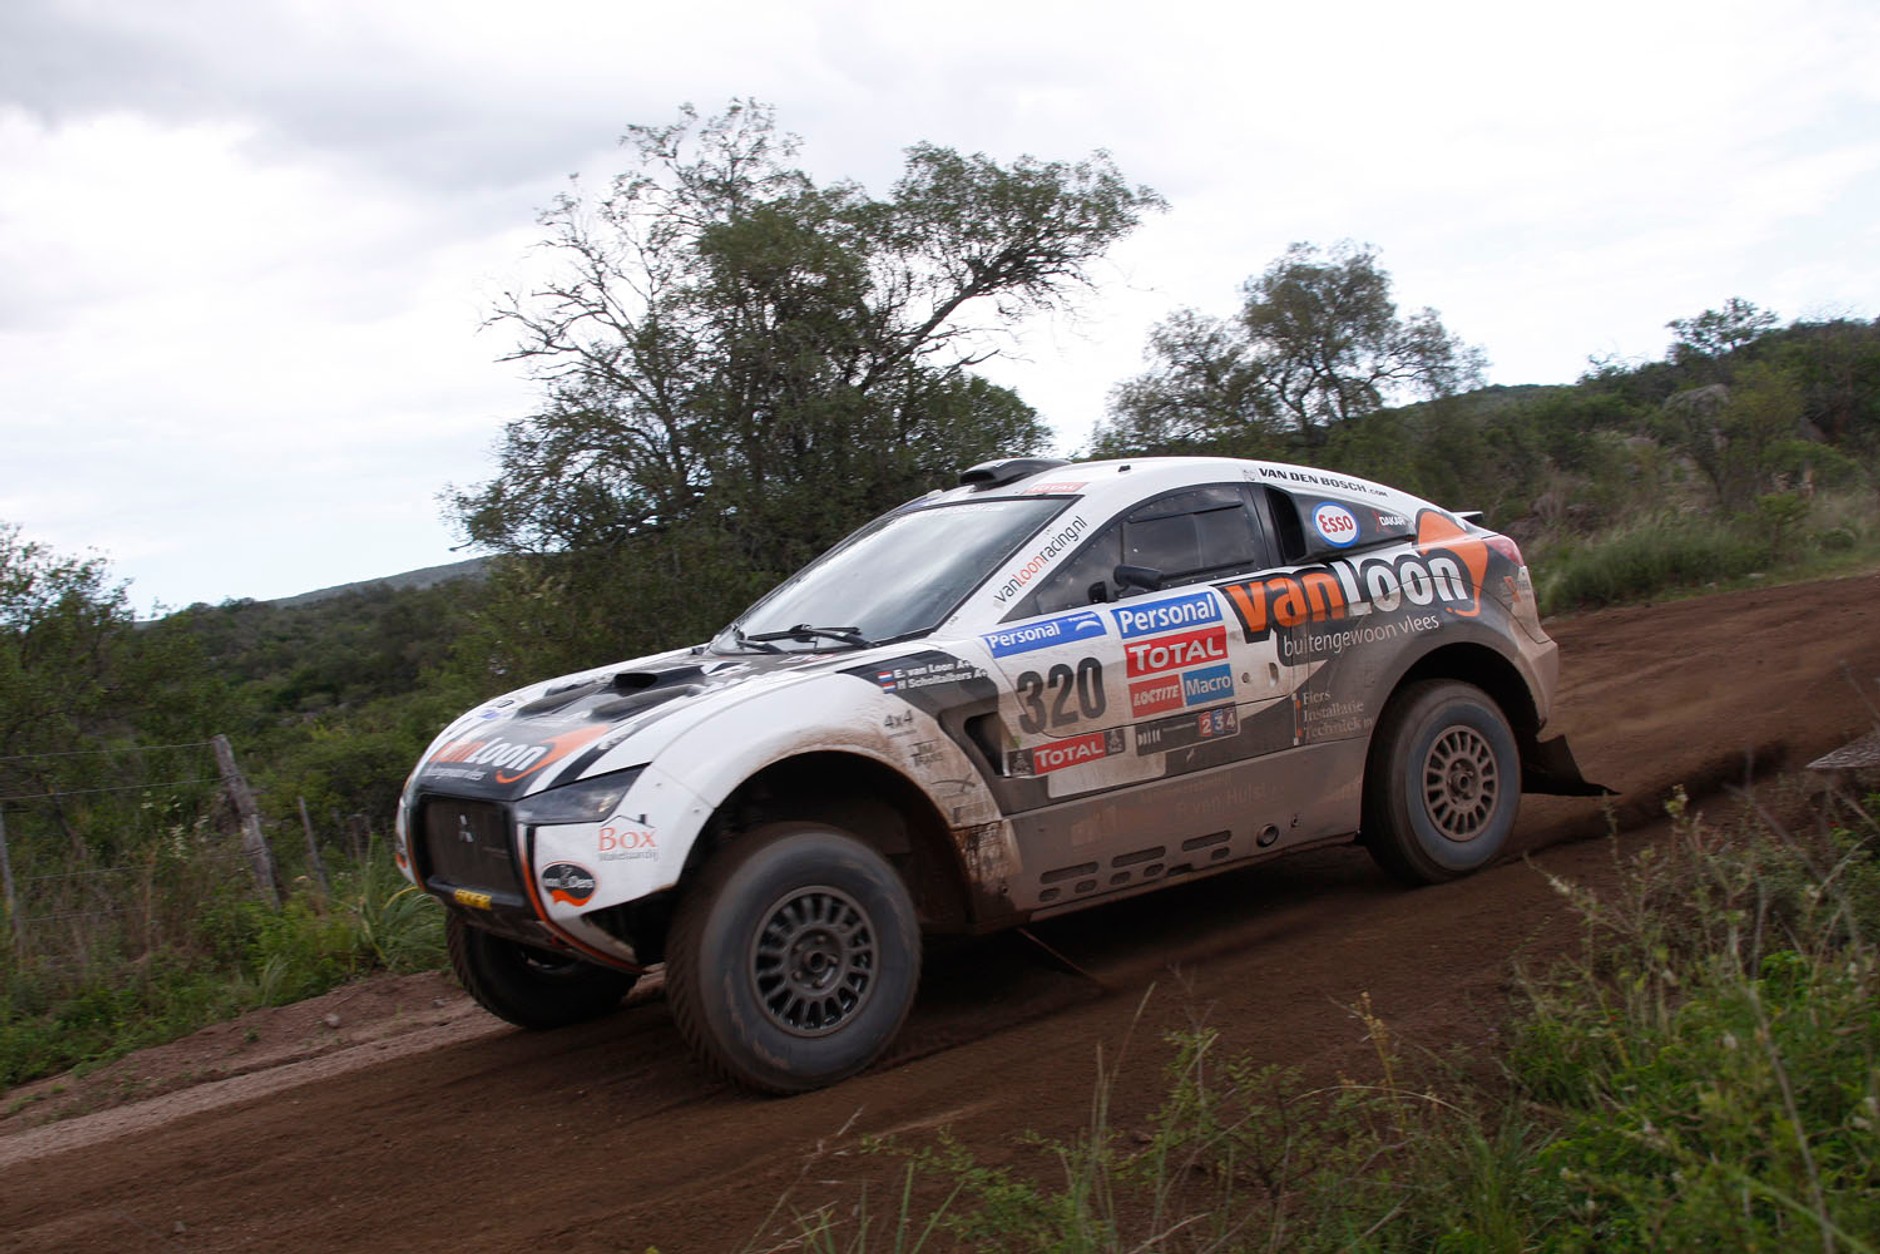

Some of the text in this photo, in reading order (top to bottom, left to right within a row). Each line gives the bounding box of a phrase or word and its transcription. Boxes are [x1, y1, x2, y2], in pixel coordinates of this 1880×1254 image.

[1258, 468, 1287, 480] VAN
[1290, 472, 1319, 484] DEN
[1321, 477, 1367, 493] BOSCH
[1118, 598, 1217, 634] Personal
[988, 621, 1062, 651] Personal
[1284, 611, 1440, 658] buitengewoon vlees
[1129, 639, 1225, 672] TOTAL
[1016, 657, 1108, 736] 320
[1132, 684, 1182, 708] LOCTITE
[1184, 675, 1233, 697] Macro
[1034, 740, 1104, 768] TOTAL
[598, 827, 657, 852] Box
